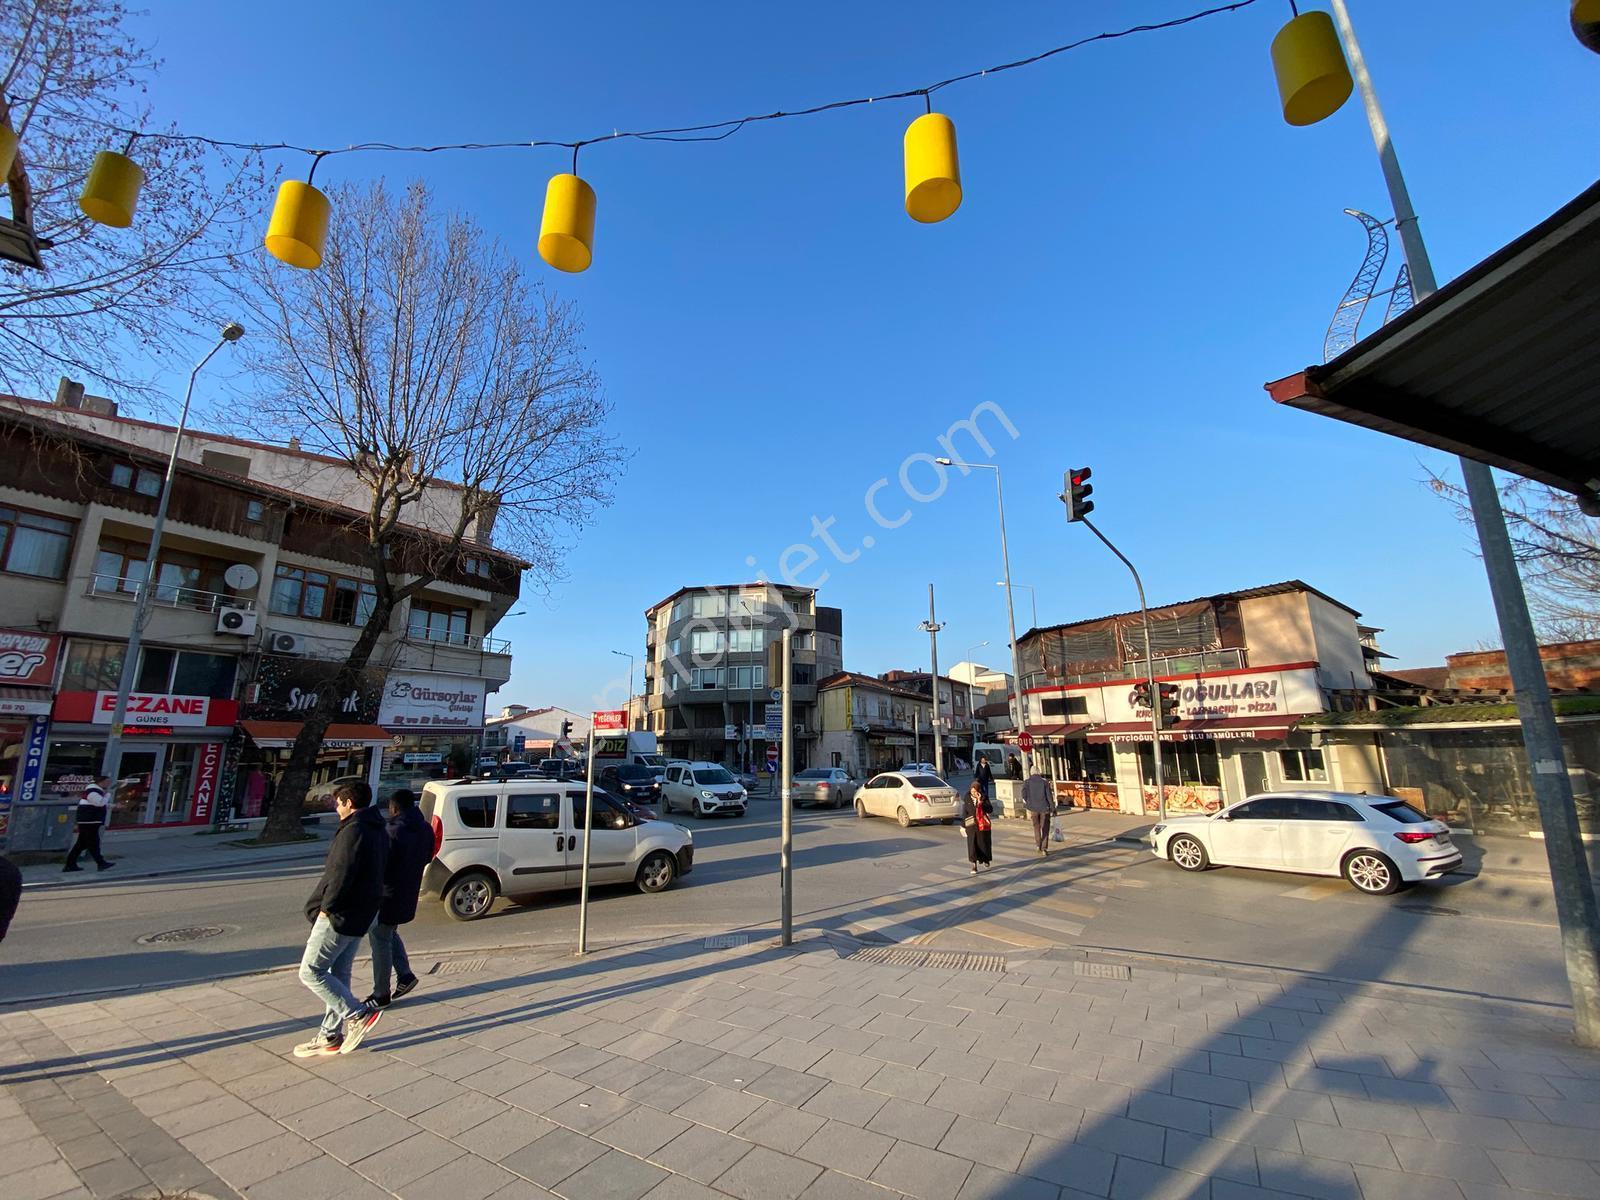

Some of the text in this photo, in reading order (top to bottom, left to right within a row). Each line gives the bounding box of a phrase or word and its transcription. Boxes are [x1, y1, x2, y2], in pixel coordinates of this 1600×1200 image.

[411, 687, 477, 704] Gürsoylar
[1247, 702, 1278, 712] PİZZA
[136, 715, 169, 724] GÜNEŞ
[1206, 729, 1256, 740] MAMÜLLERİ
[1019, 737, 1033, 746] DUR
[196, 743, 218, 817] ECZANE
